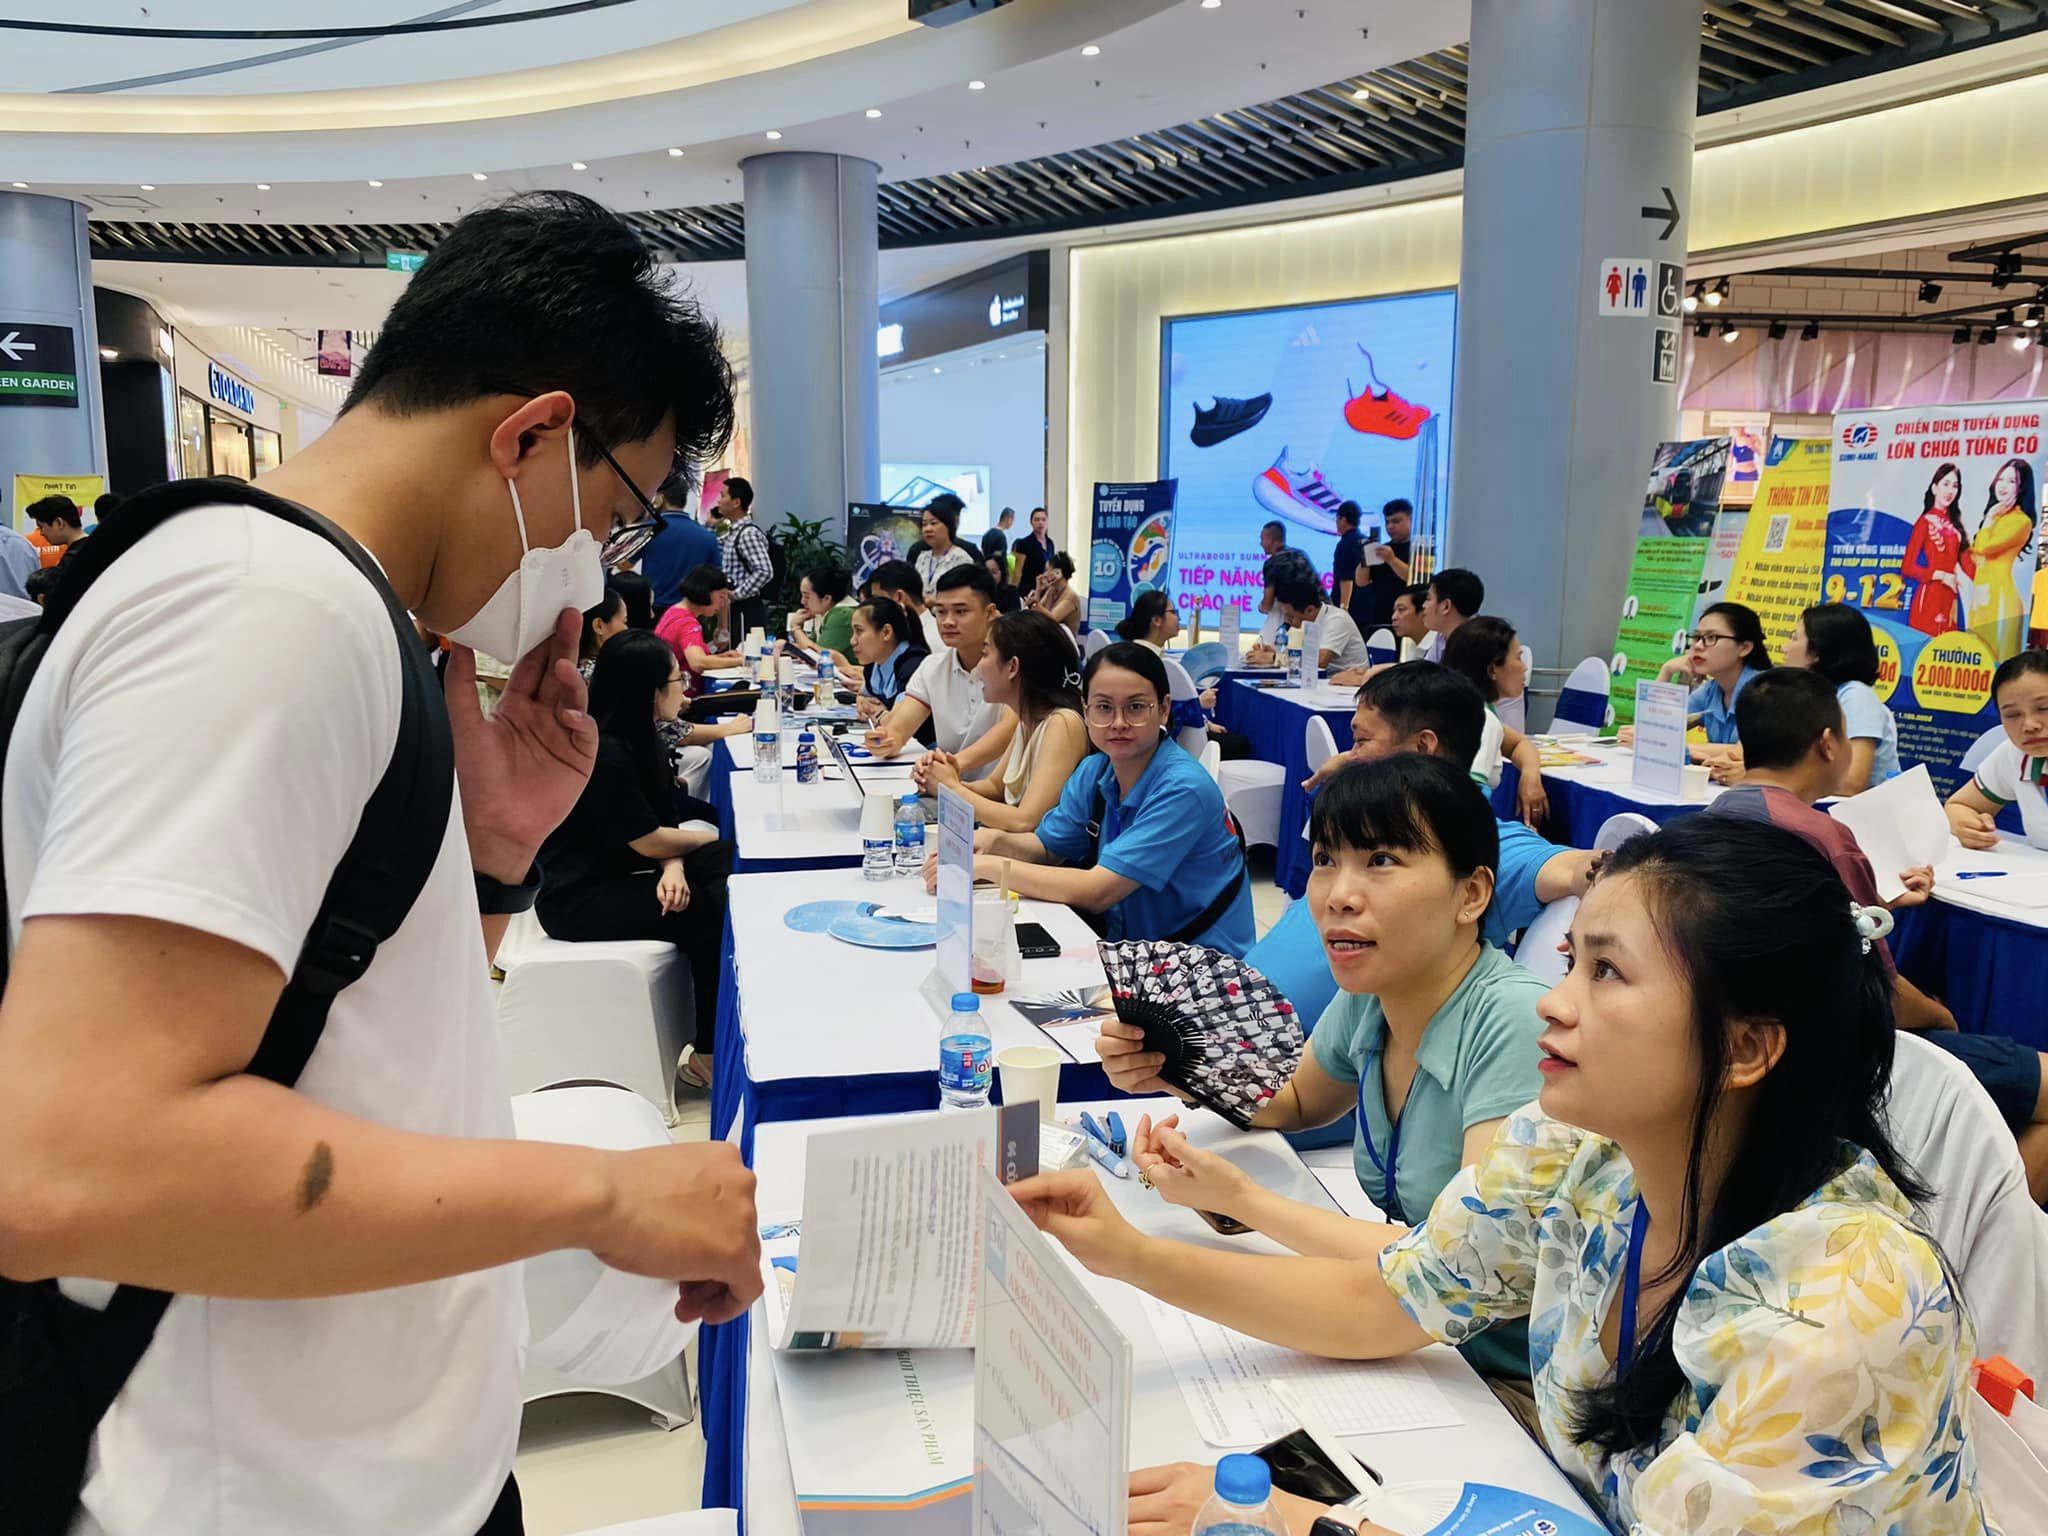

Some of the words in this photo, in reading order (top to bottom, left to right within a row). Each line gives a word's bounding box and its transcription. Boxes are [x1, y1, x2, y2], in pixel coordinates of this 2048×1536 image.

[22, 378, 74, 391] GARDEN
[209, 362, 255, 415] GIORDANO
[1895, 417, 1929, 436] CHIẾN
[1933, 419, 1959, 436] DỊCH
[1963, 412, 1998, 432] TUYỂN
[2004, 415, 2040, 430] DỤNG
[1887, 436, 1915, 459] LỚN
[1921, 436, 1960, 458] CHƯA
[1966, 433, 2009, 456] TỪNG
[2013, 433, 2039, 454] CÓ
[1178, 552, 1236, 561] ULTRABOOST
[1094, 560, 1116, 577] 10
[1179, 563, 1215, 585] TIẾP
[1826, 573, 1906, 609] 9-12
[1932, 647, 1982, 666] THƯỞNG
[1916, 663, 1991, 692] 2.000.000đ
